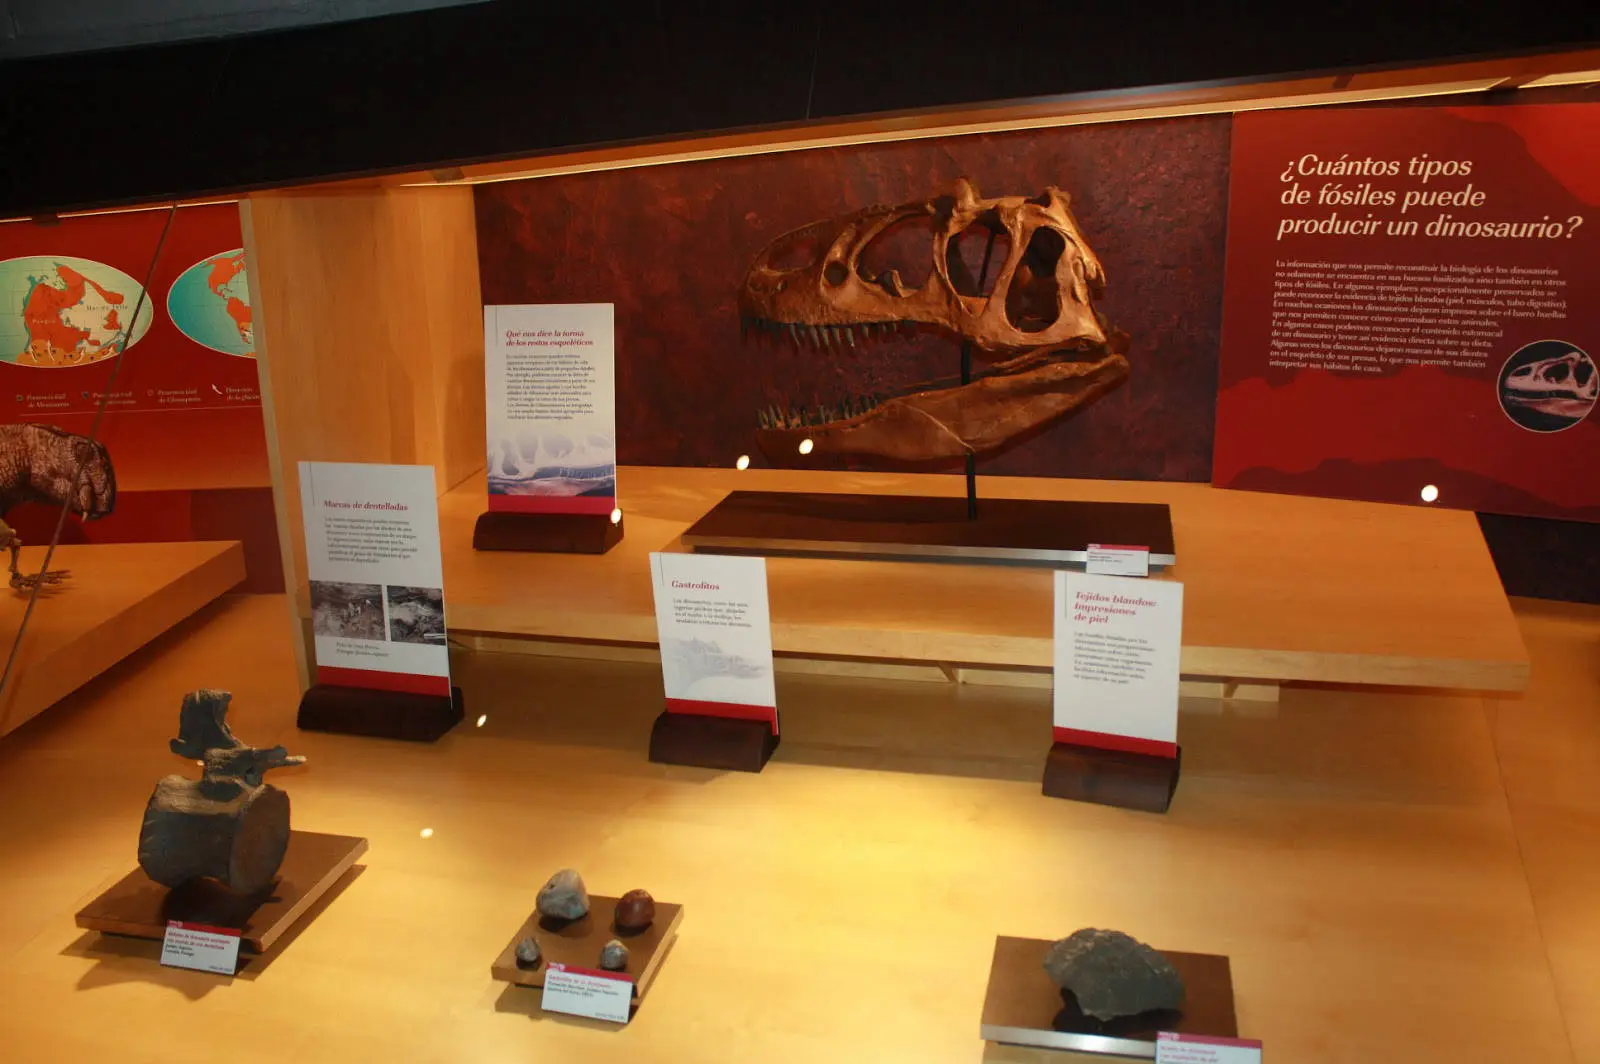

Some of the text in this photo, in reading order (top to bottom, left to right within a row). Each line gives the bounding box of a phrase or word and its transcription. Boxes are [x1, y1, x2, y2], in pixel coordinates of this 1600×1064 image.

[1280, 154, 1472, 183] ¿Cuántos tipos
[1281, 183, 1486, 214] de fósiles puede
[1277, 213, 1584, 240] producir un dinosaurio?
[1285, 260, 1330, 268] información
[1331, 263, 1347, 271] que
[1363, 262, 1394, 272] permite
[1394, 263, 1438, 271] reconstruir
[1449, 264, 1481, 274] biología
[1495, 265, 1508, 273] los
[1509, 265, 1558, 274] dinosaurios
[1286, 270, 1325, 278] solamente
[1403, 273, 1431, 281] huesos
[1494, 276, 1529, 284] también
[1274, 280, 1293, 289] tipos
[1344, 282, 1374, 292] algunos
[1419, 284, 1492, 296] excepcionalmente
[1493, 287, 1544, 297] preservados
[1273, 290, 1296, 299] puede
[1341, 292, 1376, 300] evidencia
[1376, 293, 1387, 301] de
[1387, 294, 1413, 303] tejidos
[1414, 295, 1444, 303] blandos
[1445, 296, 1464, 306] (piel,
[1466, 297, 1505, 305] músculos,
[1506, 298, 1525, 306] tubo
[1284, 300, 1313, 308] muchas
[1364, 303, 1408, 312] dinosaurios
[1512, 309, 1535, 317] barro
[1536, 310, 1566, 318] huellas
[1272, 311, 1287, 319] que
[1302, 311, 1337, 321] permiten
[1392, 315, 1436, 323] caminaban
[1283, 320, 1311, 330] algunos
[1335, 322, 1370, 332] podemos
[1411, 325, 1419, 333] el
[1420, 326, 1460, 335] contenido
[1461, 328, 1503, 337] estomacal
[1292, 330, 1331, 339] dinosaurio
[1370, 334, 1407, 343] evidencia
[1407, 335, 1435, 344] directa
[1436, 337, 1459, 345] sobre
[1270, 339, 1299, 349] Algunas
[1319, 341, 1332, 349] los
[1332, 342, 1374, 351] dinosaurios
[1433, 347, 1444, 355] de
[1459, 348, 1488, 357] dientes
[1268, 359, 1307, 369] interpretar
[1351, 355, 1377, 363] presas,
[1388, 357, 1403, 365] que
[1420, 358, 1451, 367] permite
[1452, 358, 1485, 367] también
[352, 501, 362, 509] de
[364, 501, 408, 511] dentelladas
[1075, 591, 1110, 605] Tejidos
[1074, 613, 1109, 626] de piel
